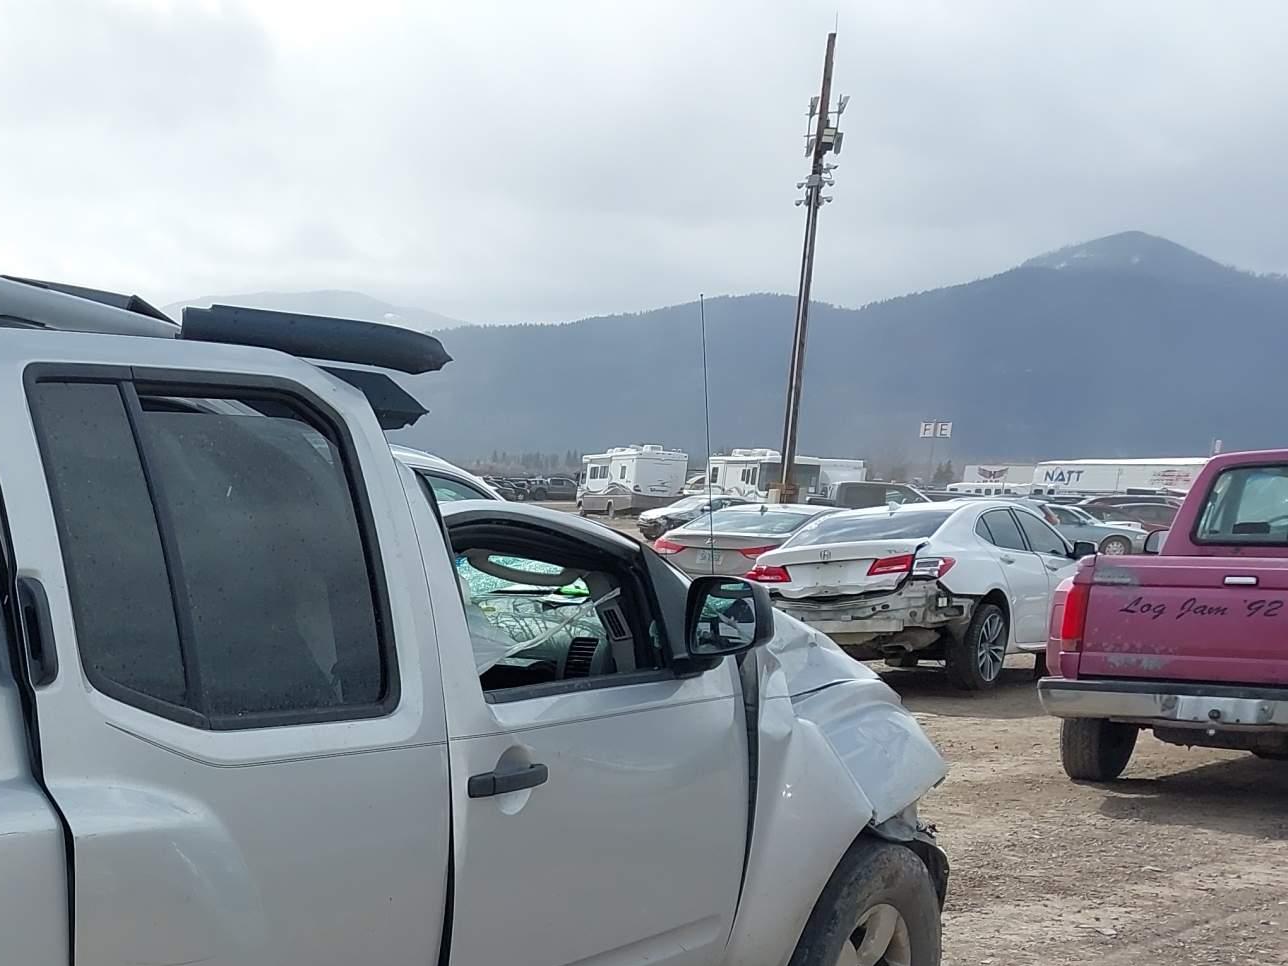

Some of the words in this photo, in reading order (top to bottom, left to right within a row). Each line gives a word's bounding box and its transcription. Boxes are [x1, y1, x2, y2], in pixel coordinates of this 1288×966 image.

[1044, 467, 1084, 485] NATT
[1120, 596, 1167, 619] Log
[1176, 597, 1228, 620] Jam
[1243, 599, 1284, 617] '92
